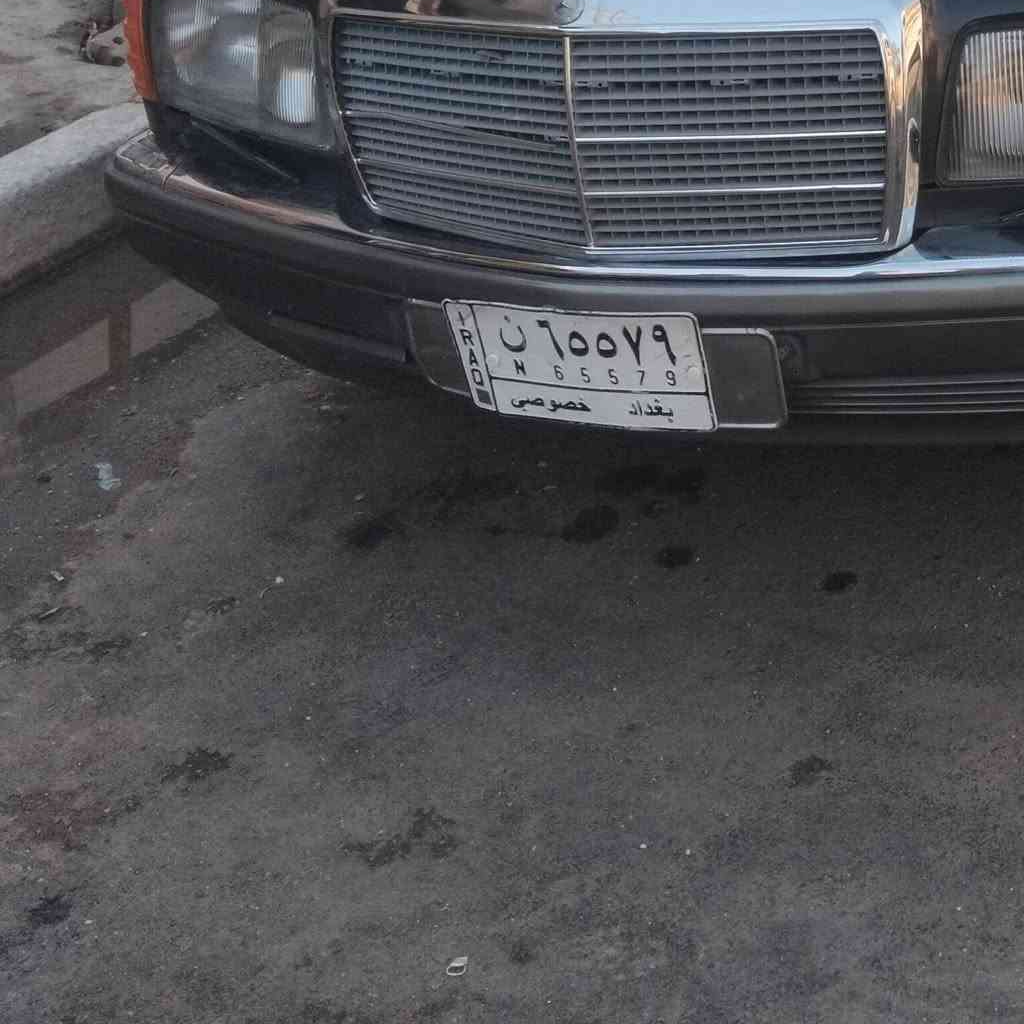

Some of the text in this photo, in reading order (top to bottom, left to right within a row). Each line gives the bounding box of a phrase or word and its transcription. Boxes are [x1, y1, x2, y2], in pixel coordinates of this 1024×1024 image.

[457, 311, 484, 387] IRAQ
[500, 314, 677, 366] ن ٦٥٥٧٩
[514, 358, 527, 375] N
[511, 396, 675, 423] بغداد خصوصي
